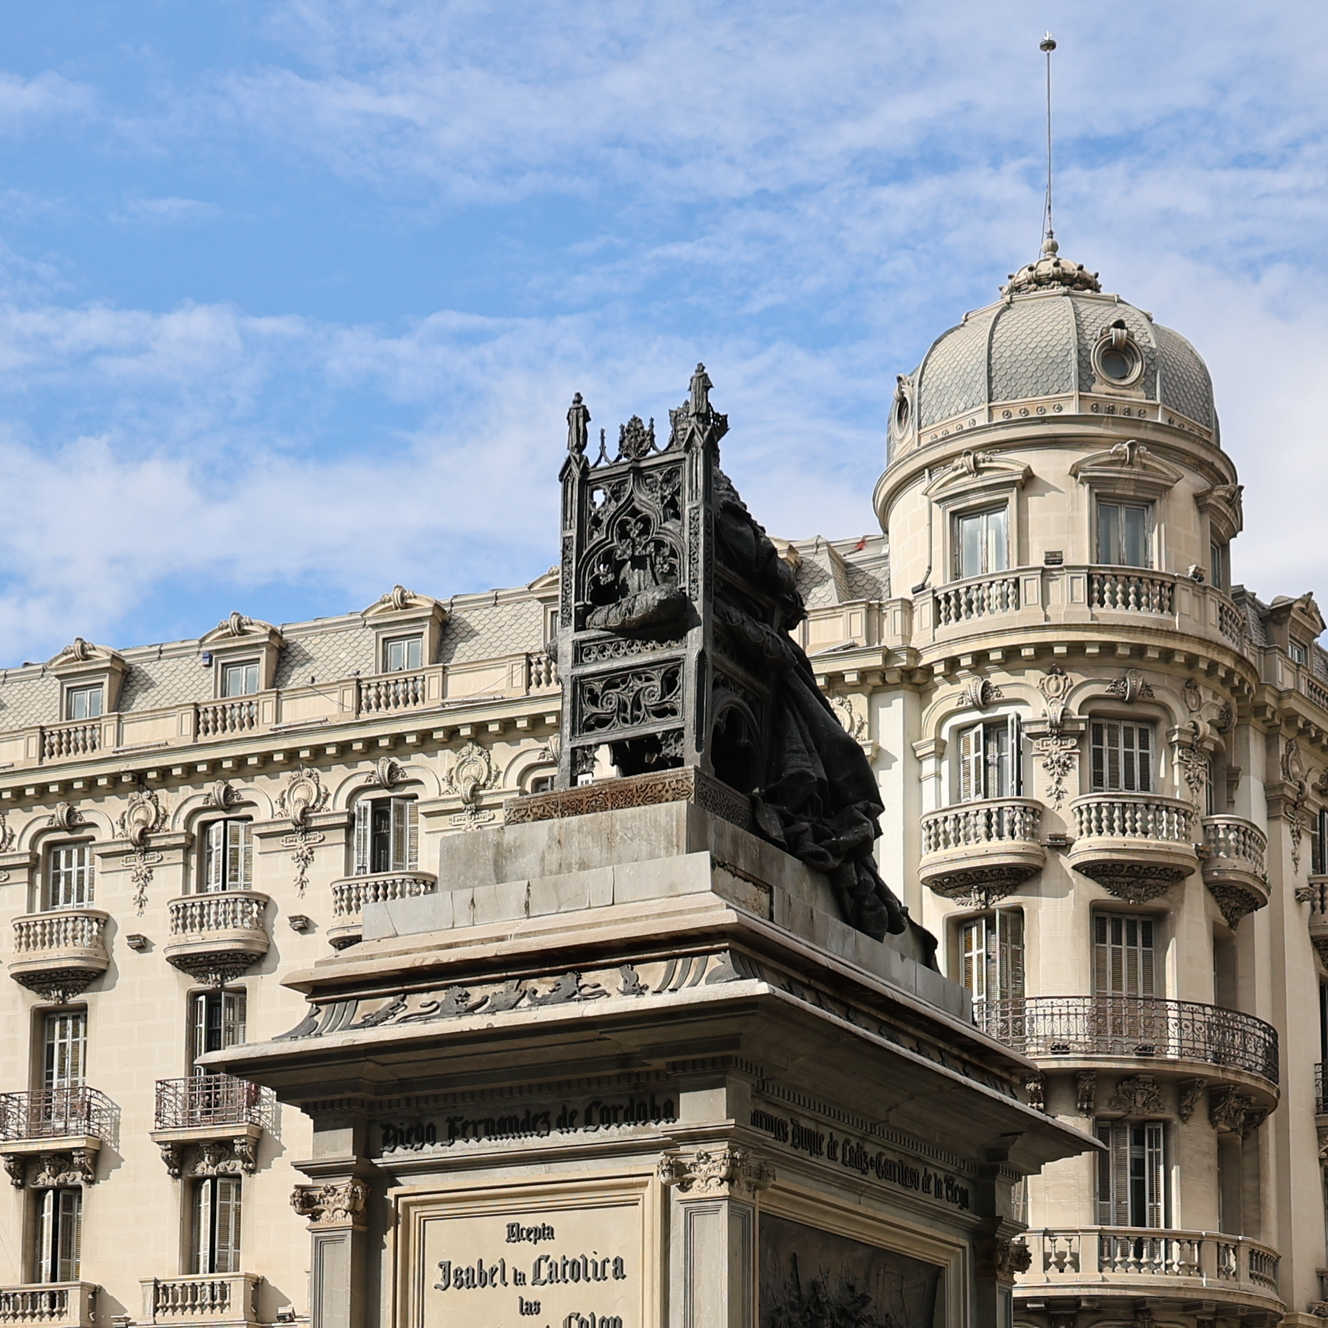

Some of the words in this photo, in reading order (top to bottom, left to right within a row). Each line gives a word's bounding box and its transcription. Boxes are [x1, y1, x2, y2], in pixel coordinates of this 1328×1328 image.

[380, 1119, 437, 1153] Diego
[556, 1103, 578, 1134] de
[827, 1131, 840, 1162] de
[505, 1222, 555, 1245] Acepta
[433, 1257, 509, 1291] Isabel
[512, 1266, 527, 1286] la
[530, 1250, 627, 1287] Catolica
[518, 1295, 541, 1316] las
